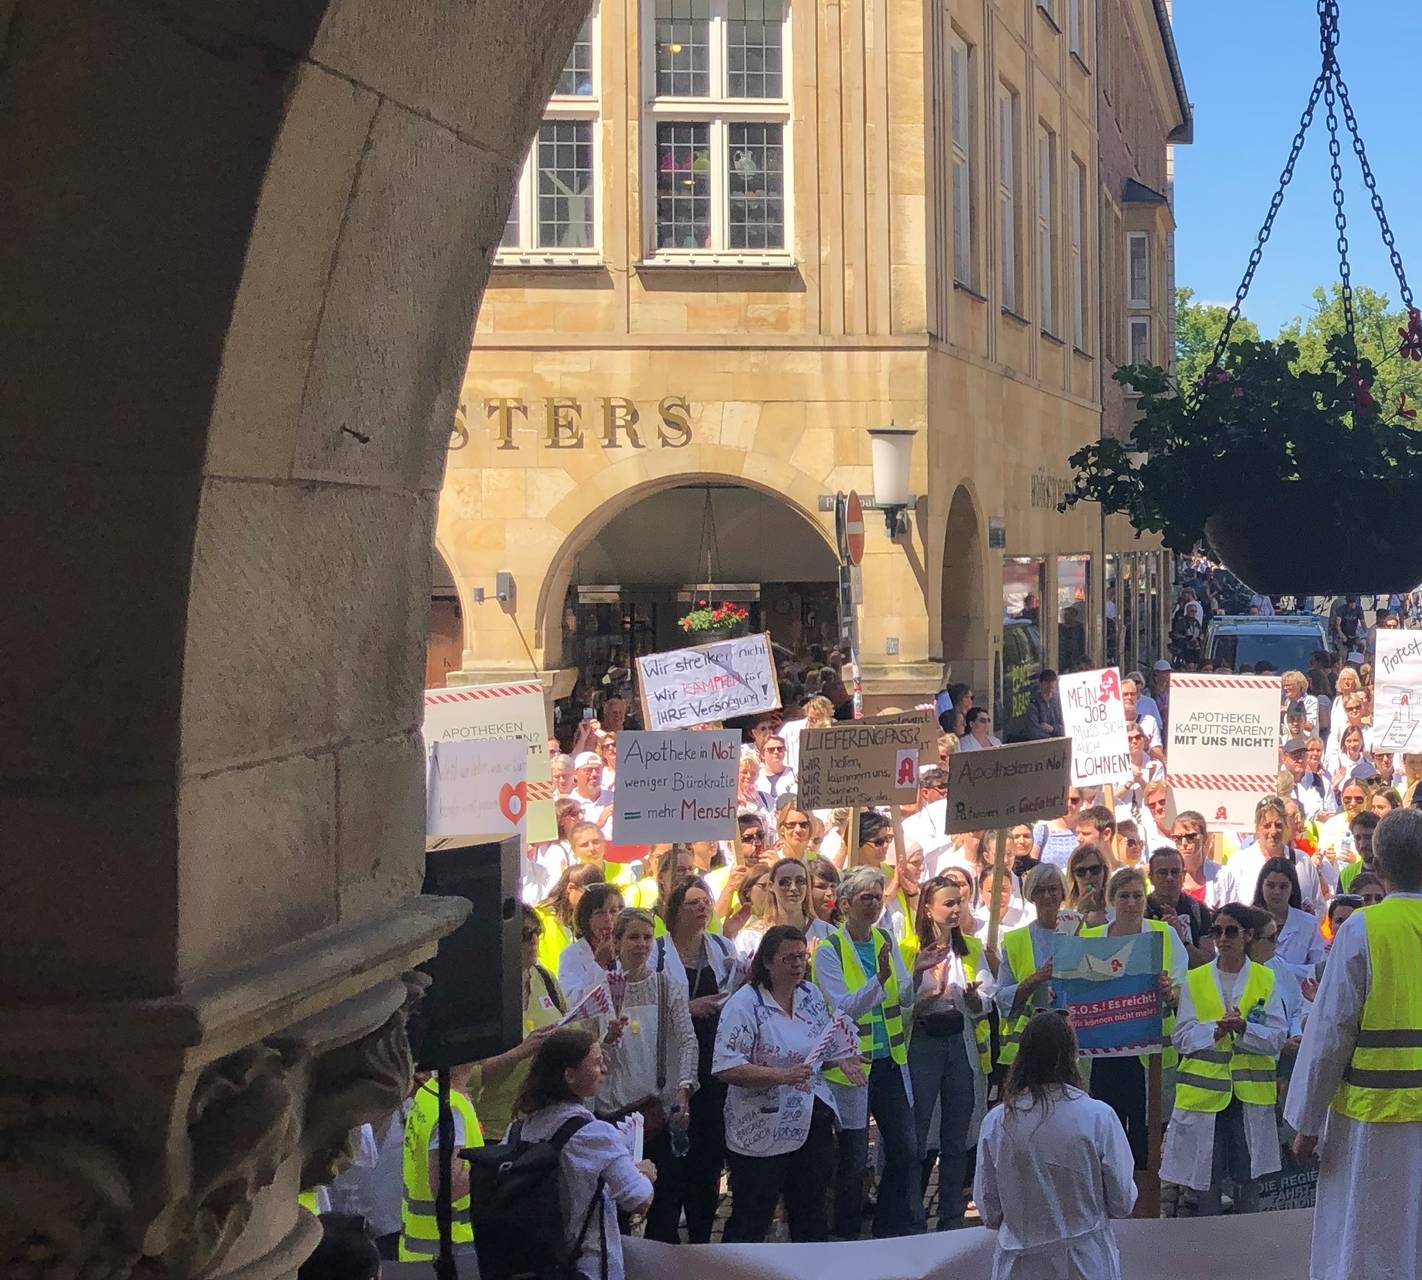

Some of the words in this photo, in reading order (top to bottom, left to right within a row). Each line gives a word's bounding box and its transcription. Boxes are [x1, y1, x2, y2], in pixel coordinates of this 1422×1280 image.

[642, 659, 668, 678] Wir
[738, 643, 766, 658] nicht
[1381, 638, 1422, 674] Protest
[653, 687, 678, 703] Wir
[1067, 681, 1098, 708] MEIN
[657, 706, 687, 725] IHRE
[1084, 704, 1107, 723] JOB
[1189, 712, 1261, 723] APOTHEKEN
[442, 721, 524, 739] APOTHEKEN
[806, 726, 920, 752] LIEFERENGPASS?
[1175, 723, 1274, 736] KAPUTTSPAREN?
[1174, 735, 1198, 746] MIT
[1201, 736, 1228, 747] UNS
[1231, 737, 1274, 748] NICHT!
[624, 739, 696, 768] Apotheke
[700, 746, 708, 759] in
[711, 741, 735, 760] Not
[1075, 752, 1132, 778] LOHNEN!
[624, 778, 667, 792] weniger
[672, 772, 735, 792] Bürokratie
[647, 804, 677, 819] mehr
[681, 798, 736, 821] Mensch
[1108, 1000, 1121, 1010] Es
[1122, 993, 1157, 1007] reicht!
[1114, 1012, 1135, 1022] nicht
